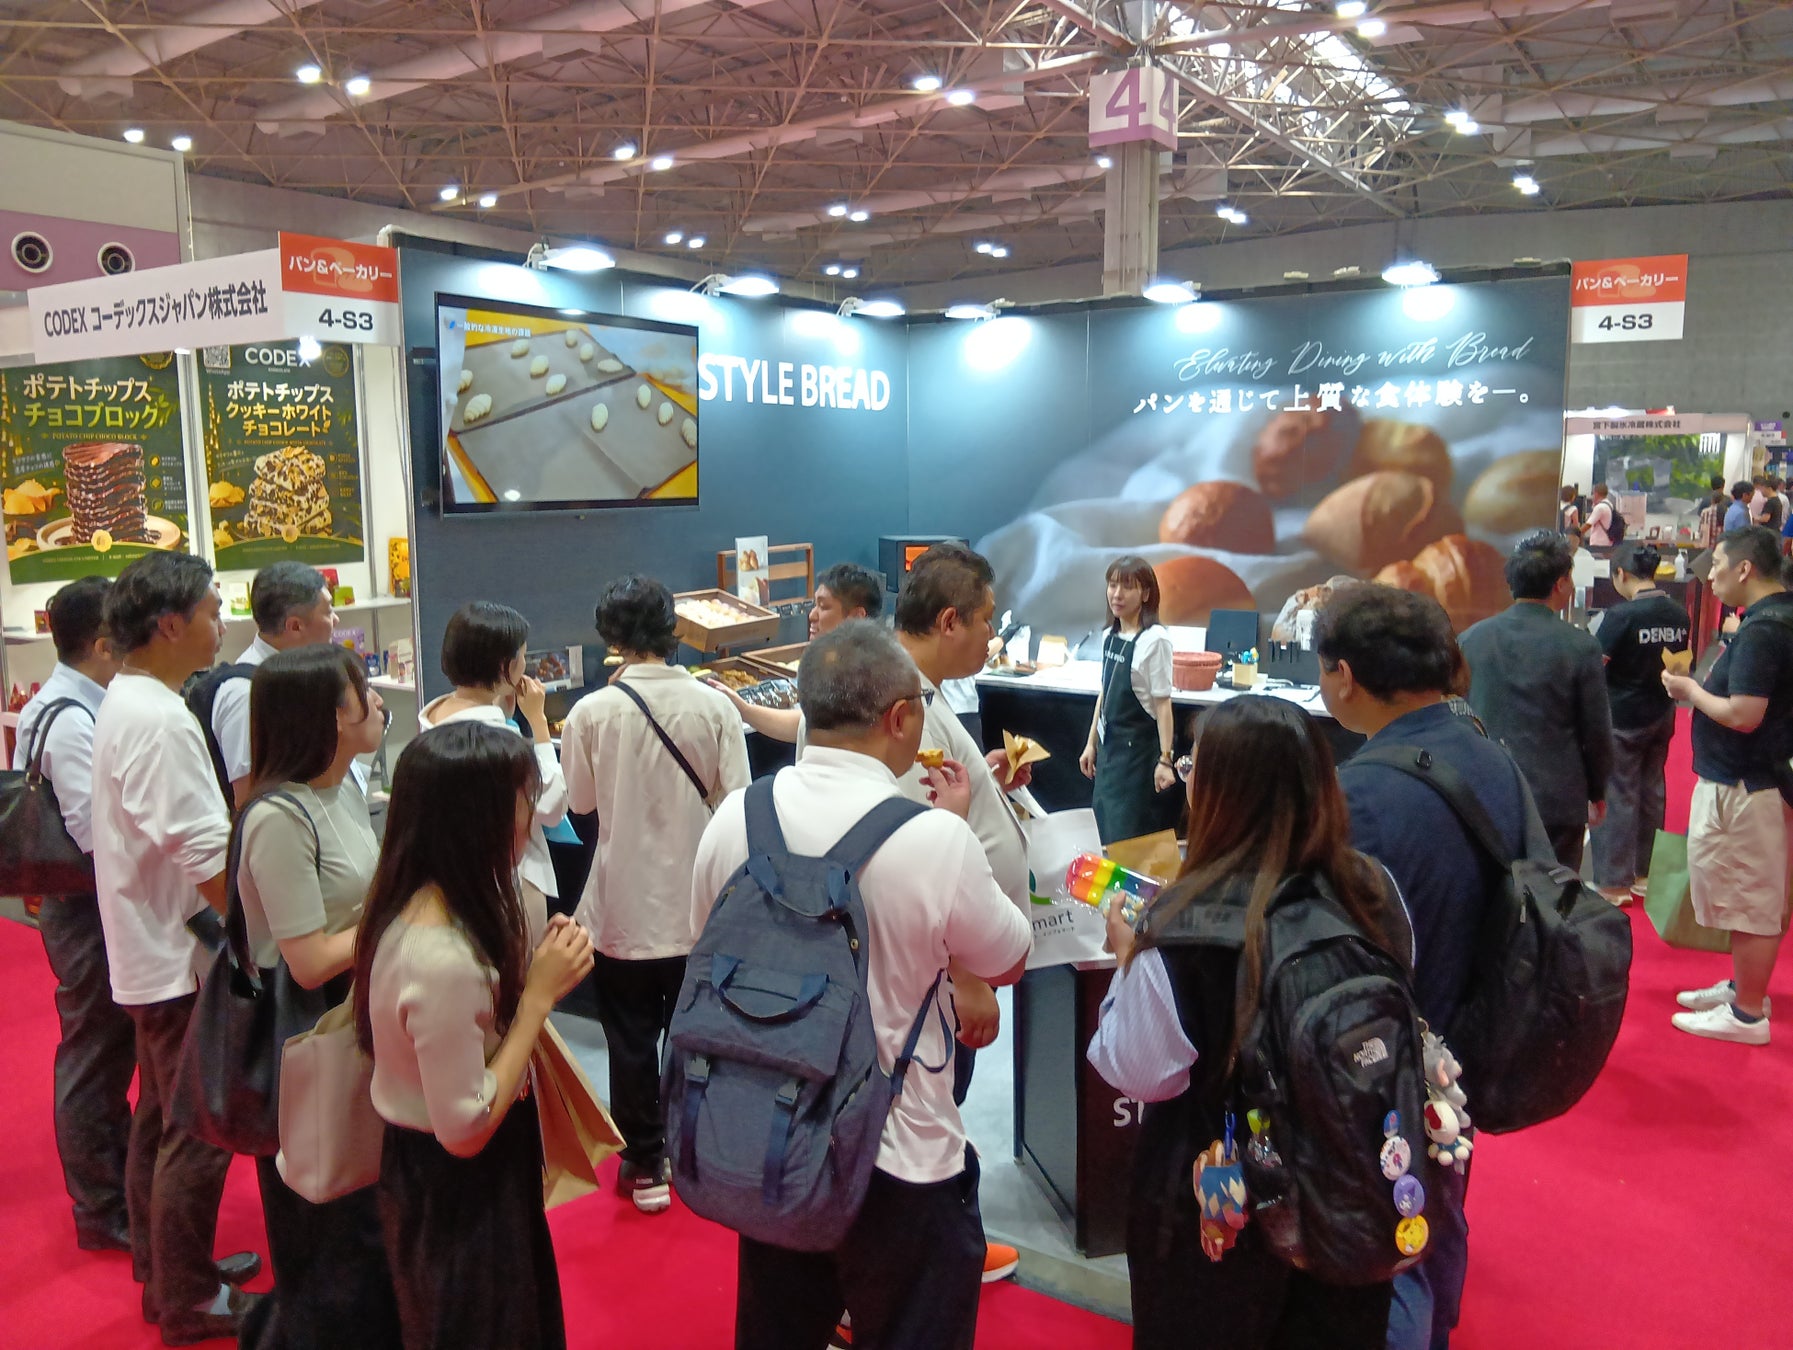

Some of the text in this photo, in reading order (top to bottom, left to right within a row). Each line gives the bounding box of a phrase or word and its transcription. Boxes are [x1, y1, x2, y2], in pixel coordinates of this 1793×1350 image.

[1106, 67, 1146, 128] 4
[1159, 73, 1177, 133] 4
[288, 255, 393, 281] パン&ベーカリー
[1575, 272, 1679, 291] パン&ベーカリー
[44, 279, 269, 337] CODEX コーデックスジャパン株式会社
[318, 308, 374, 331] 4-S3
[1598, 313, 1654, 331] 4-S3
[1287, 340, 1371, 376] Dining
[1378, 336, 1438, 368] with
[1446, 331, 1534, 369] Bread
[23, 372, 152, 402] ポテトチップス
[227, 379, 335, 404] ポテトチップス
[698, 352, 891, 411] STYLE BREAD
[23, 401, 159, 428] チョコブロック
[242, 419, 321, 438] チョコレート
